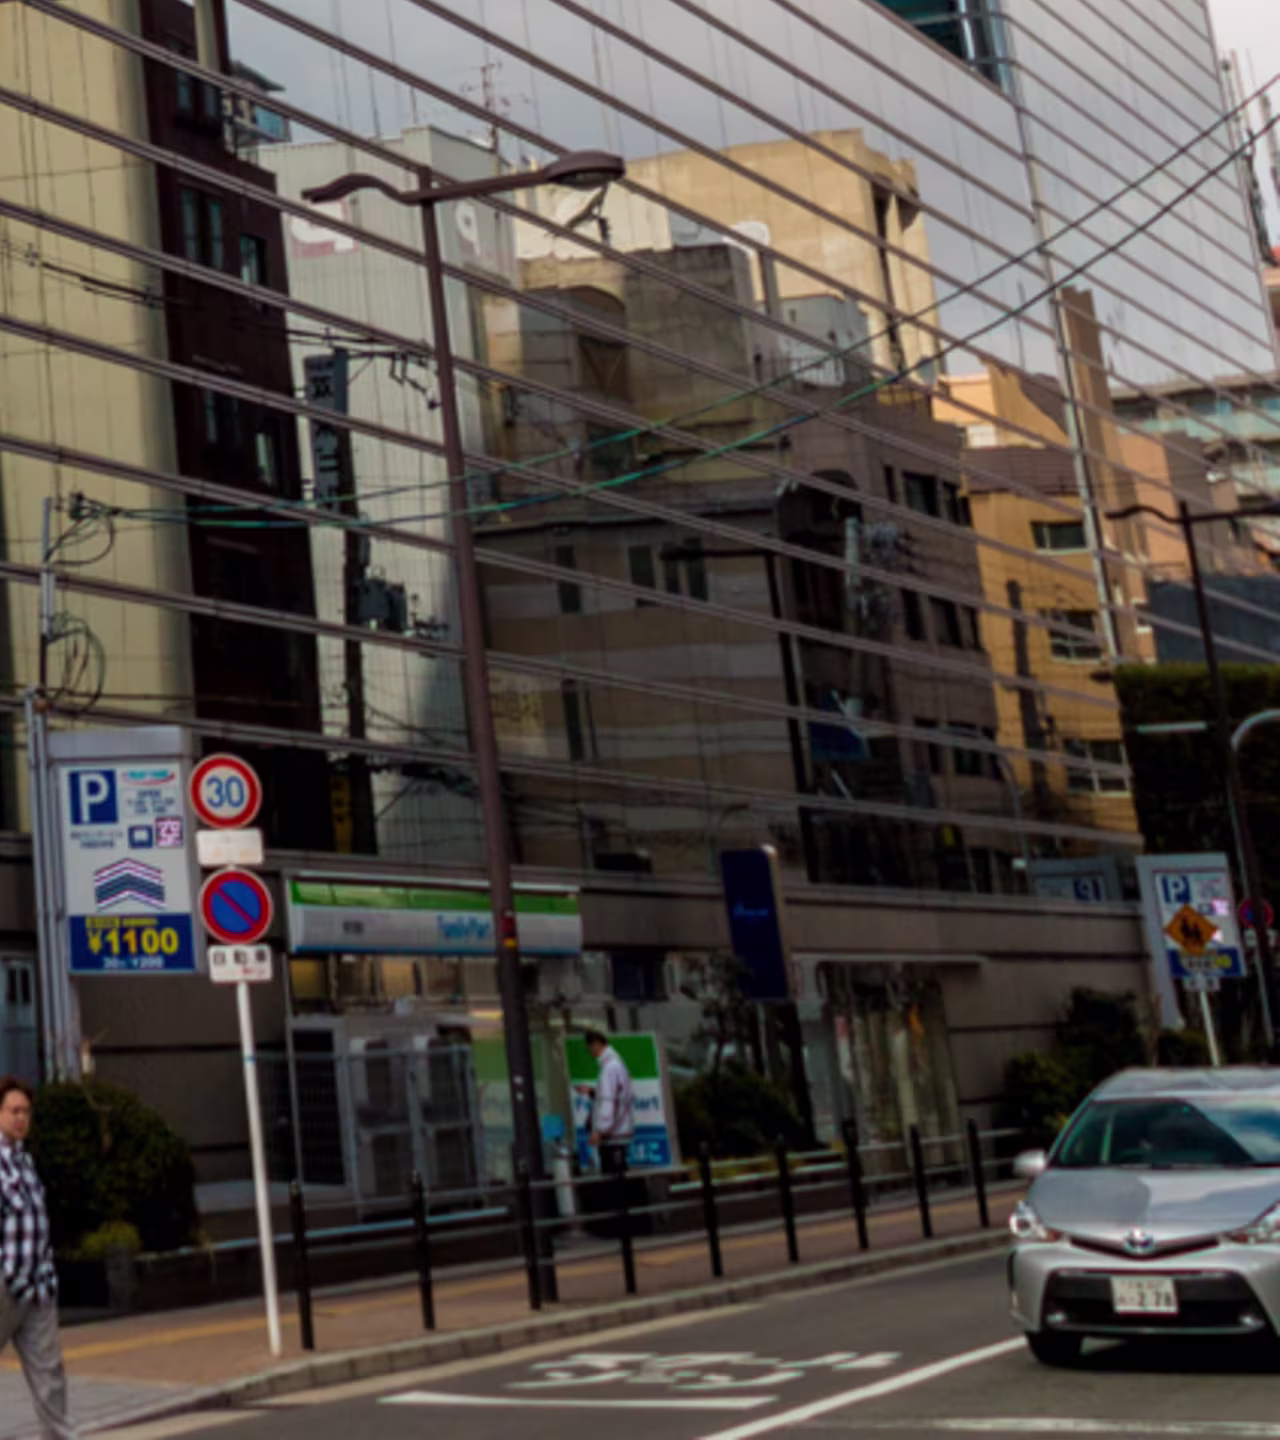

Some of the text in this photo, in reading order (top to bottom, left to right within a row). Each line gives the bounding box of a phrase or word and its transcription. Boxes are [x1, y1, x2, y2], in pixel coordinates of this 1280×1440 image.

[78, 772, 110, 823] P
[206, 776, 245, 808] 30
[1168, 875, 1187, 902] P
[86, 927, 179, 955] ¥1100
